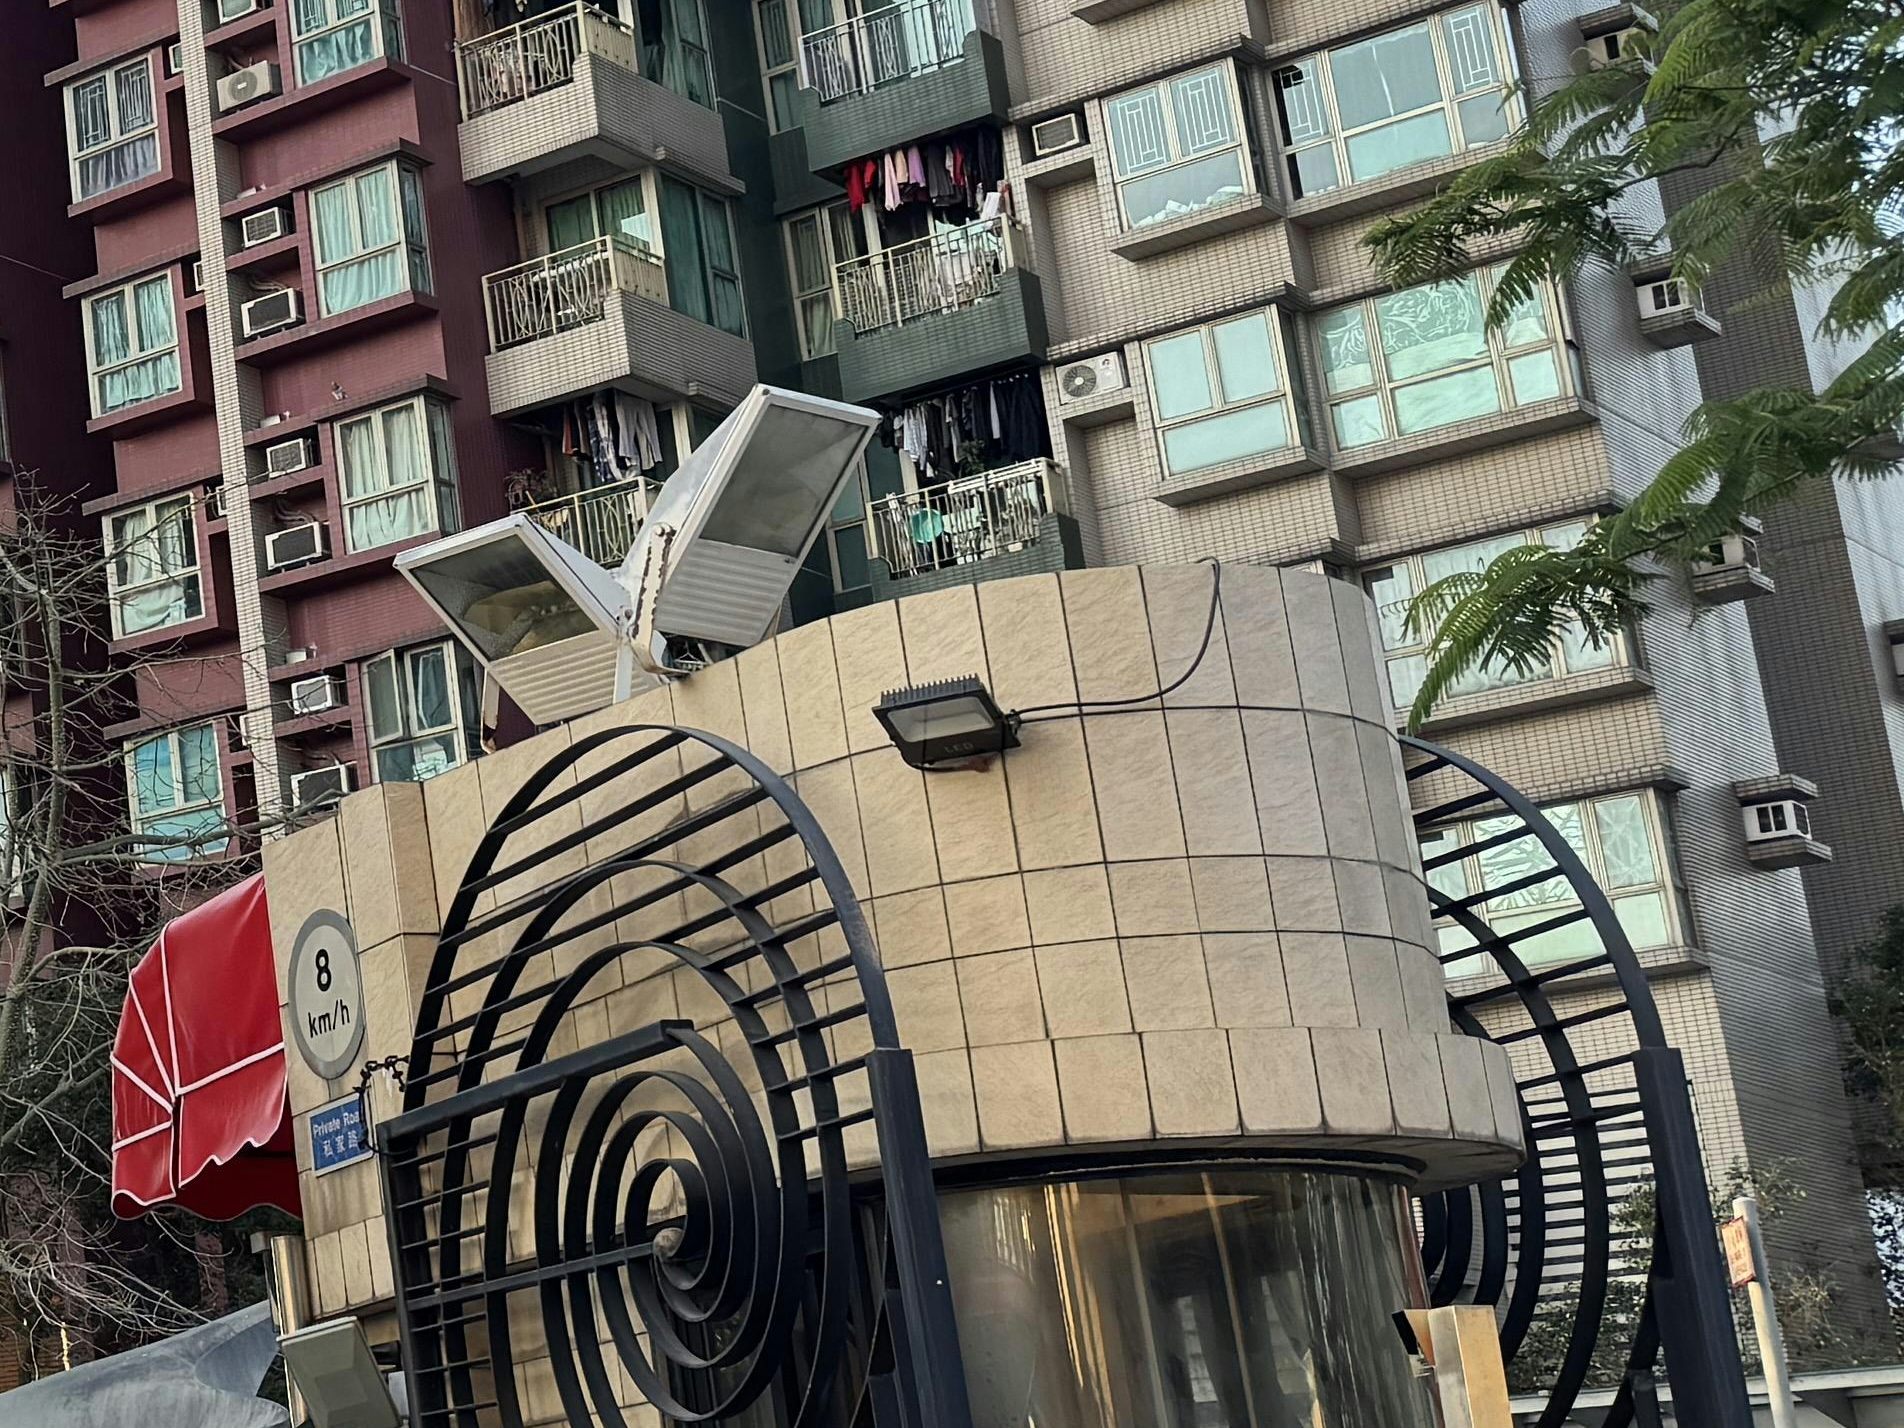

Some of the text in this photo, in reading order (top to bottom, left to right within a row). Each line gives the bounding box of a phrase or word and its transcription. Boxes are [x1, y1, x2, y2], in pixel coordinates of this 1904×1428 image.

[315, 948, 332, 992] 8
[308, 999, 350, 1039] km/h
[312, 1110, 363, 1138] Private Roa
[322, 1131, 360, 1157] 私家路
